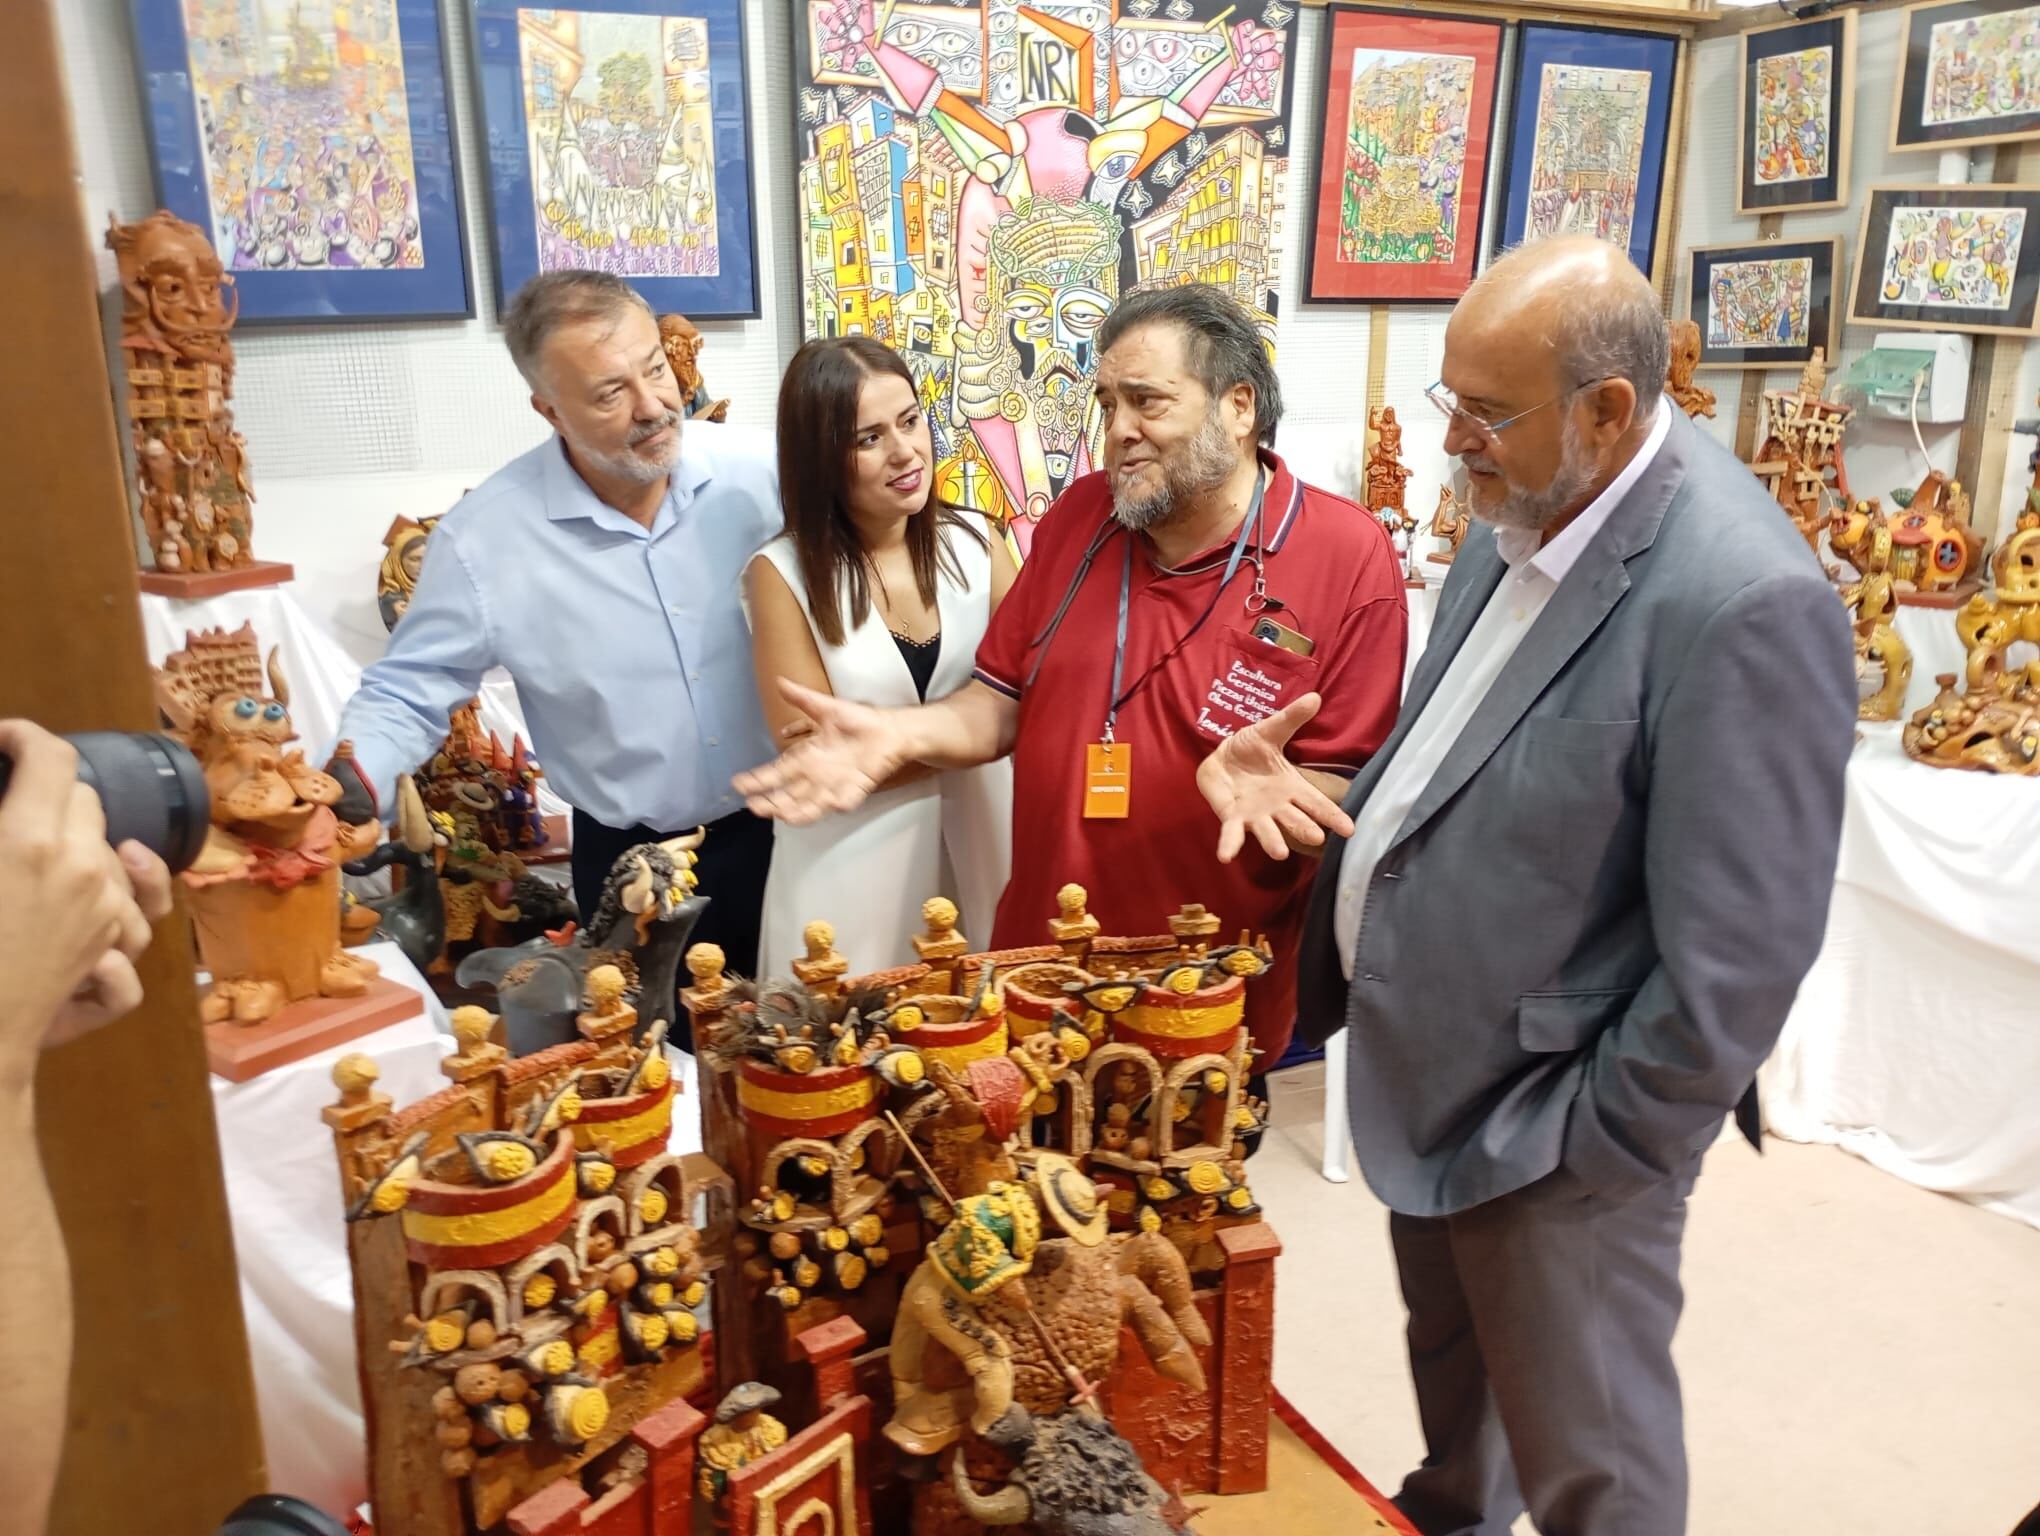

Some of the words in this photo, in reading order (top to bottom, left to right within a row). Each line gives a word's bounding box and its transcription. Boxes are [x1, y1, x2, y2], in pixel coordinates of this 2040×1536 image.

[1019, 31, 1080, 104] INRI
[1211, 678, 1245, 702] Piezas
[1227, 672, 1276, 702] Cerámica
[1231, 660, 1282, 690] Escultura
[1207, 691, 1233, 711] Obra
